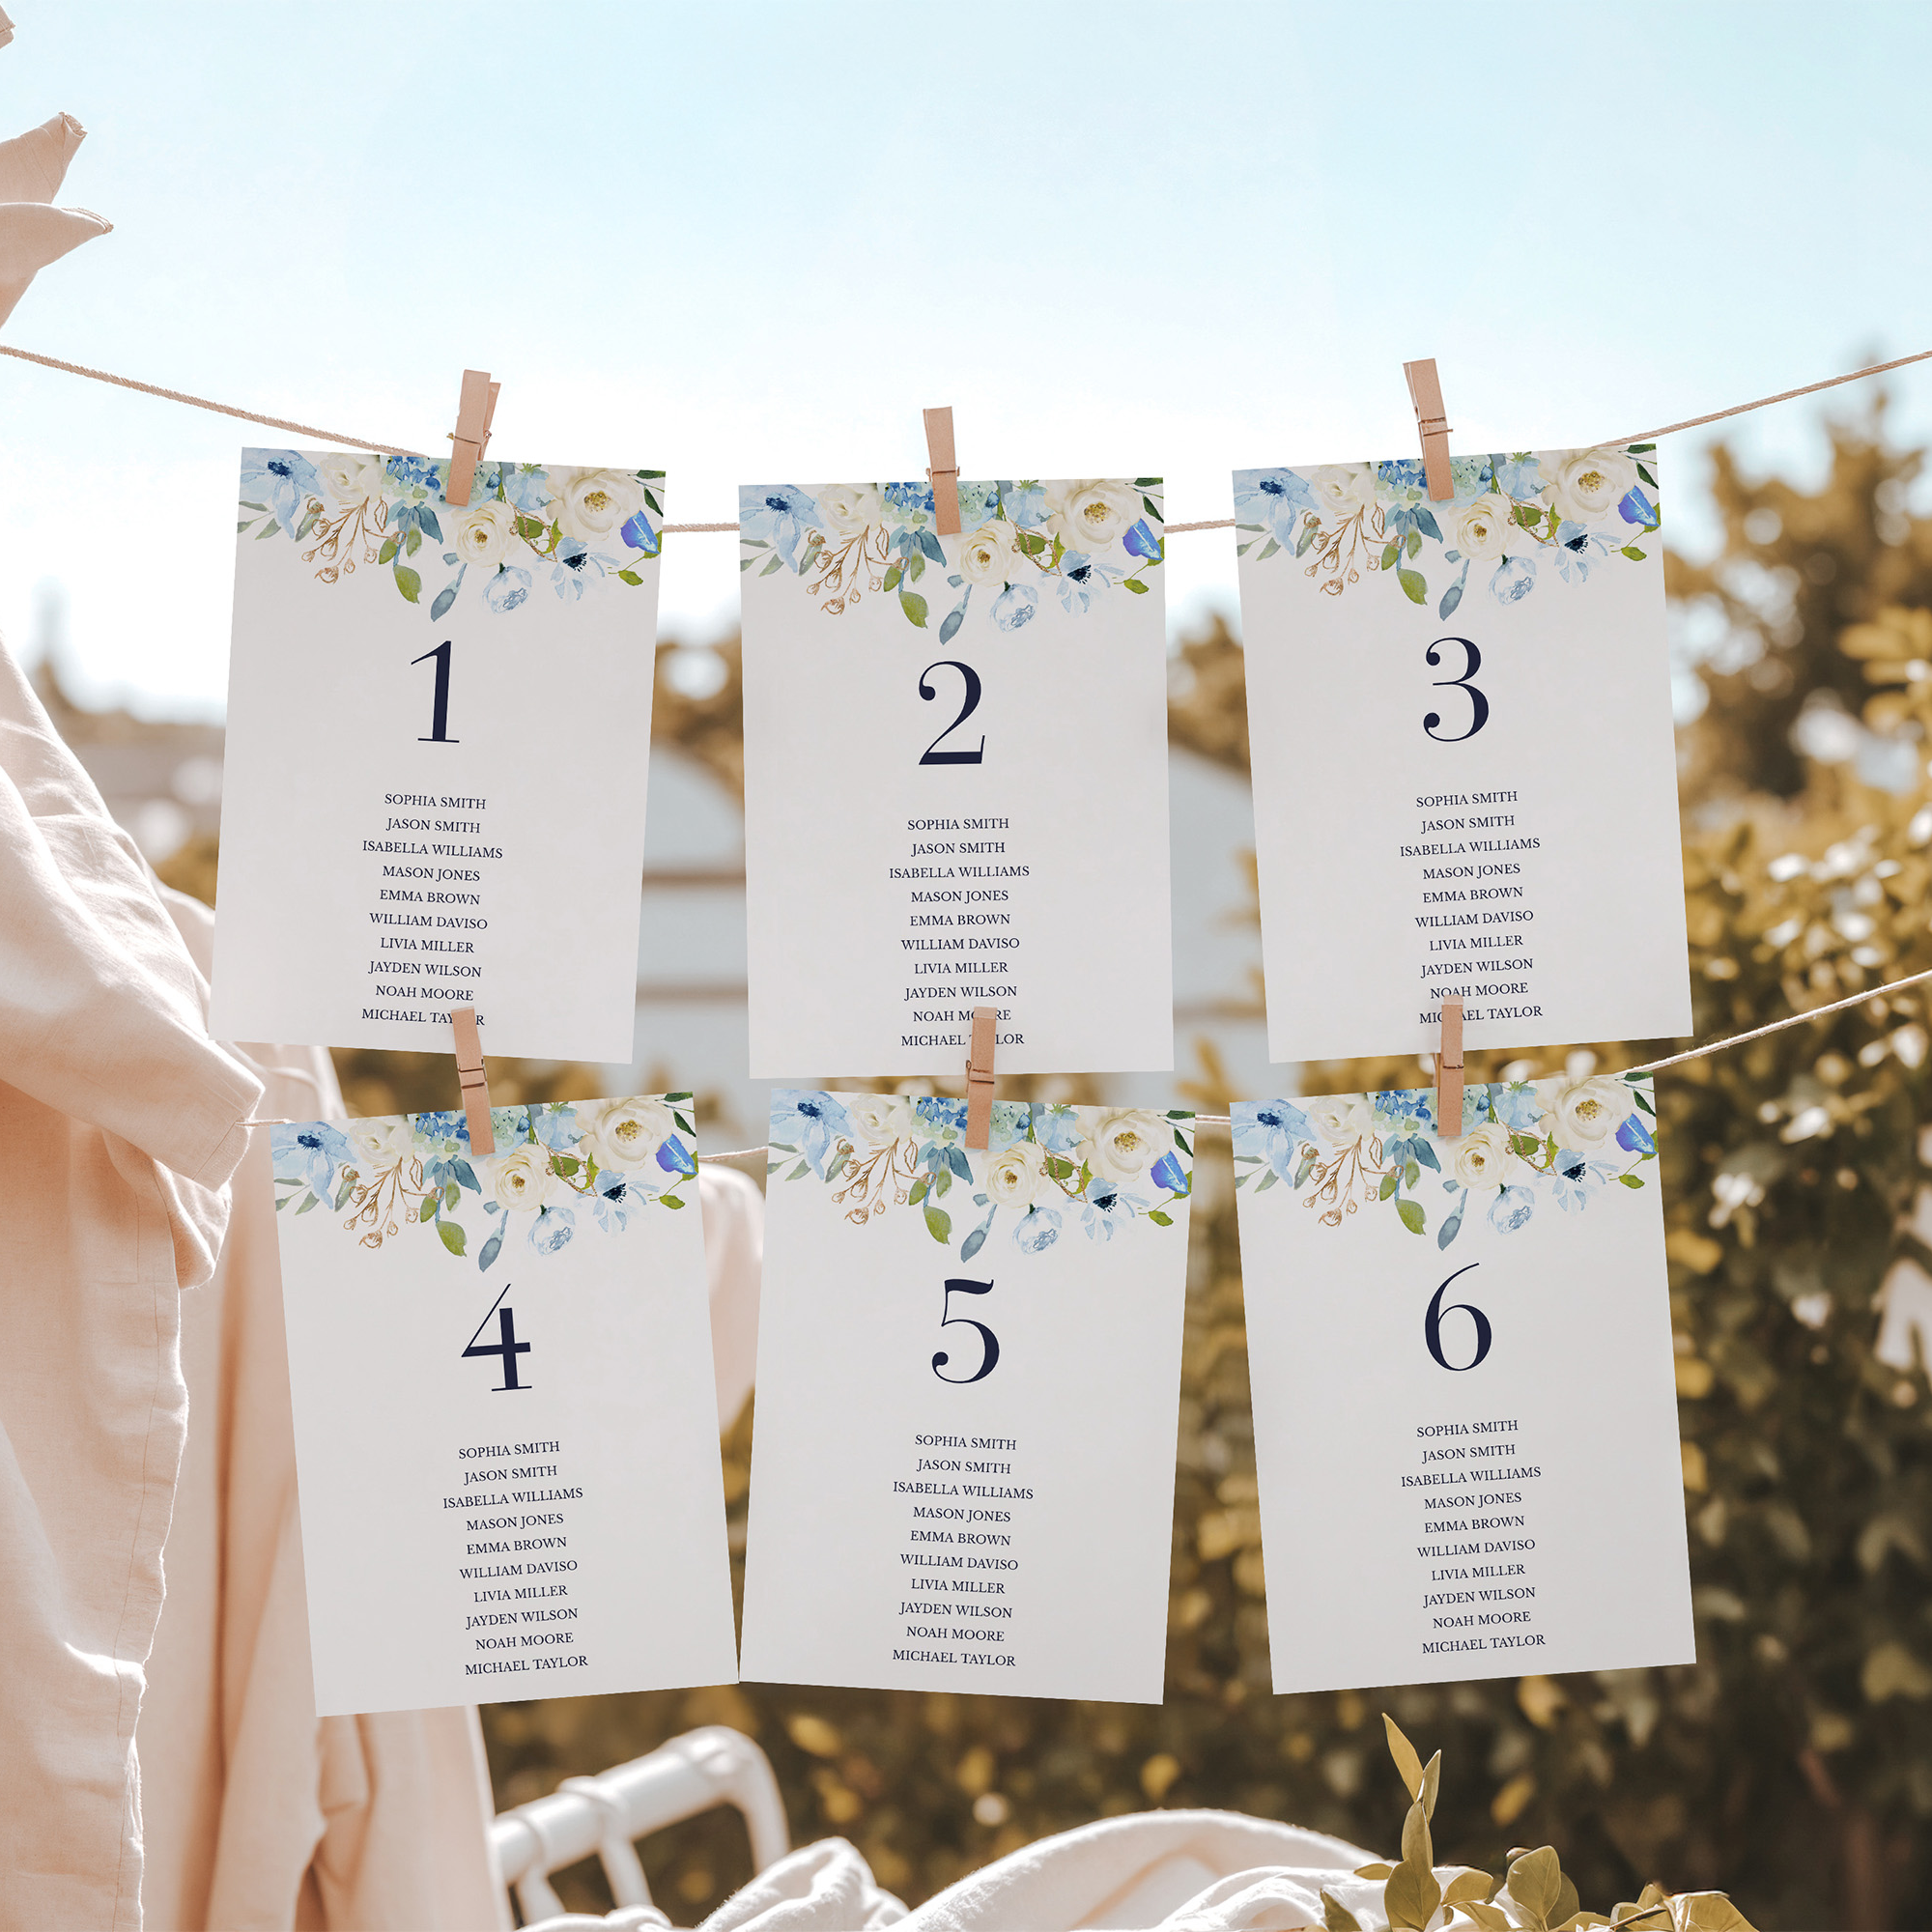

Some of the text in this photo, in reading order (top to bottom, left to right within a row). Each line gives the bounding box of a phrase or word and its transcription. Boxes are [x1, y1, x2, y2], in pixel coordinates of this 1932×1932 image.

[411, 639, 460, 744] 1
[1423, 637, 1490, 743] 3
[918, 660, 986, 766] 2
[384, 793, 487, 810] SOPHIA SMITH
[1416, 790, 1519, 809] SOPHIA SMITH
[384, 817, 481, 834] JASON SMITH
[907, 817, 1009, 831] SOPHIA SMITH
[1420, 814, 1515, 835] JASON SMITH
[362, 839, 503, 860] ISABELLA WILLIAMS
[910, 841, 1006, 858] JASON SMITH
[1400, 837, 1541, 857] ISABELLA WILLIAMS
[382, 865, 481, 883] MASON JONES
[889, 865, 1030, 879] ISABELLA WILLIAMS
[1422, 863, 1521, 880] MASON JONES
[380, 889, 481, 905] EMMA BROWN
[911, 890, 1009, 904] MASON JONES
[1422, 886, 1523, 903] EMMA BROWN
[368, 912, 488, 930] WILLIAM DAVISO
[909, 913, 1010, 926] EMMA BROWN
[1414, 909, 1534, 928] WILLIAM DAVISO
[380, 937, 475, 953] LIVIA MILLER
[900, 937, 1020, 951] WILLIAM DAVISO
[1429, 934, 1524, 952] LIVIA MILLER
[367, 960, 482, 978] JAYDEN WILSON
[914, 961, 1009, 975] LIVIA MILLER
[1420, 957, 1534, 980] JAYDEN WILSON
[375, 984, 474, 1002] NOAH MOORE
[903, 985, 1017, 1002] JAYDEN WILSON
[1430, 981, 1529, 1000] NOAH MOORE
[362, 1009, 486, 1026] MICHAEL TAYR
[914, 1009, 1011, 1022] NOAH MRE
[1487, 1006, 1543, 1020] TAYLOR
[901, 1034, 1025, 1046] MICHAEL LOR
[1424, 1262, 1492, 1372] 6
[461, 1283, 533, 1392] 4
[931, 1278, 1001, 1384] 5
[1416, 1419, 1519, 1438] SOPHIA SMITH
[458, 1440, 560, 1460] SOPHIA SMITH
[915, 1434, 1017, 1451] SOPHIA SMITH
[1421, 1443, 1516, 1464] JASON SMITH
[463, 1464, 557, 1487] JASON SMITH
[916, 1458, 1011, 1475] JASON SMITH
[1401, 1465, 1542, 1488] ISABELLA WILLIAMS
[442, 1487, 583, 1510] ISABELLA WILLIAMS
[893, 1481, 1034, 1500] ISABELLA WILLIAMS
[1424, 1492, 1522, 1510] MASON JONES
[466, 1513, 564, 1531] MASON JONES
[913, 1506, 1011, 1523] MASON JONES
[1424, 1515, 1525, 1534] EMMA BROWN
[466, 1536, 567, 1555] EMMA BROWN
[910, 1529, 1011, 1547] EMMA BROWN
[1416, 1538, 1536, 1558] WILLIAM DAVISO
[459, 1559, 578, 1579] WILLIAM DAVISO
[899, 1553, 1019, 1571] WILLIAM DAVISO
[1431, 1563, 1526, 1581] LIVIA MILLER
[473, 1584, 569, 1603] LIVIA MILLER
[911, 1577, 1006, 1595] LIVIA MILLER
[1422, 1586, 1536, 1609] JAYDEN WILSON
[465, 1607, 579, 1631] JAYDEN WILSON
[898, 1602, 1013, 1619] JAYDEN WILSON
[1432, 1610, 1532, 1630] NOAH MOORE
[474, 1632, 574, 1651] NOAH MOORE
[906, 1626, 1005, 1642] NOAH MOORE
[1422, 1634, 1547, 1655] MICHAEL TAYLOR
[465, 1655, 589, 1676] MICHAEL TAYLOR
[892, 1649, 1016, 1667] MICHAEL TAYLOR
